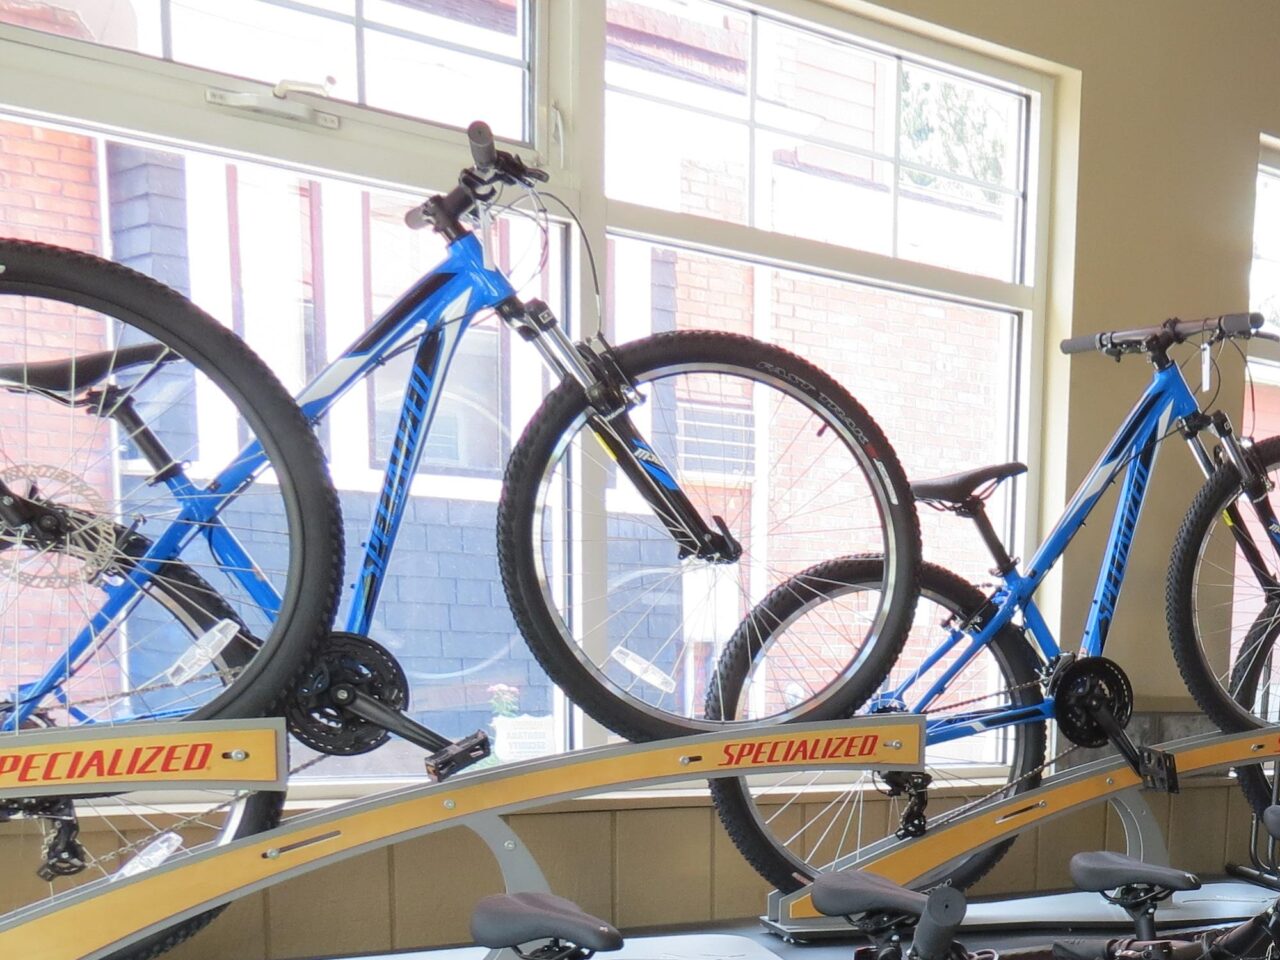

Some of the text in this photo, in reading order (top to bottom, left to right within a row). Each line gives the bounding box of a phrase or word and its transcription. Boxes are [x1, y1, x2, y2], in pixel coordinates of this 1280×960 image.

[756, 361, 869, 444] FAST TRAK
[0, 742, 213, 783] PECIALIZED
[717, 734, 879, 767] SPECIALIZED
